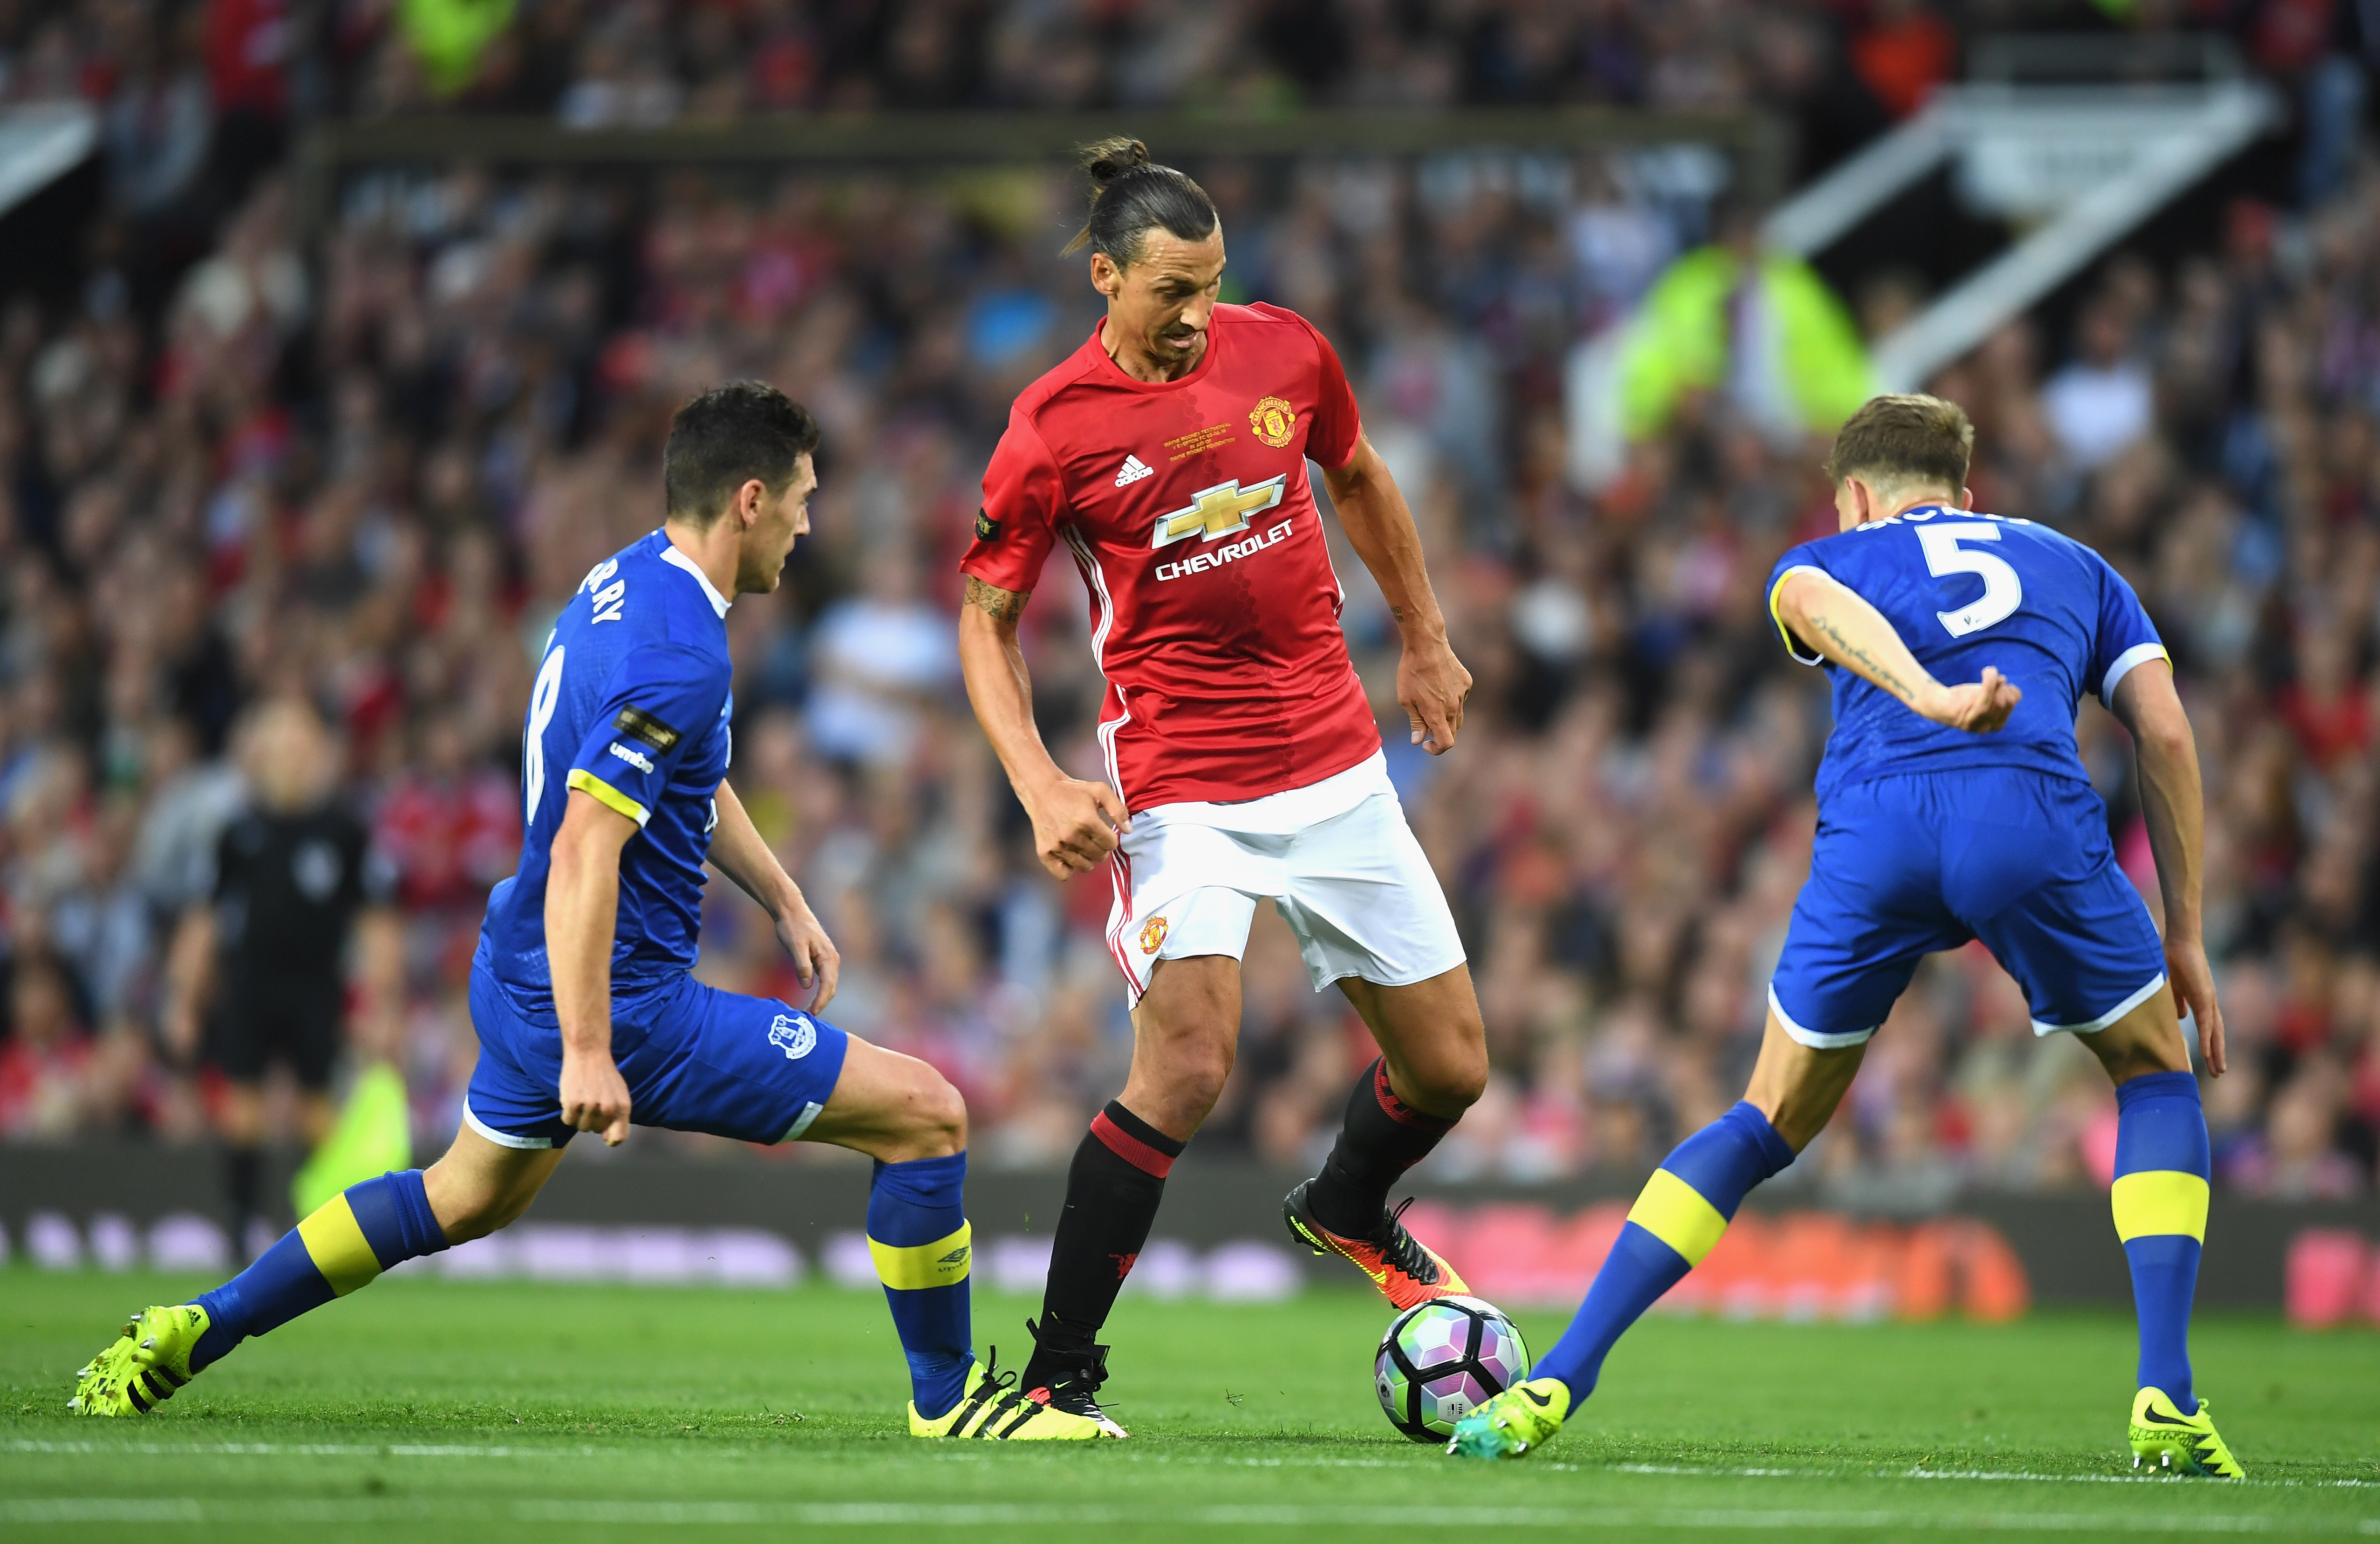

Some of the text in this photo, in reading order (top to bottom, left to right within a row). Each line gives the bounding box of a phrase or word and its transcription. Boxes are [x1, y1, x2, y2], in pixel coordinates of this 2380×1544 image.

[1254, 399, 1288, 421] MANCHESTER
[1164, 423, 1231, 447] WAYNE ROONEY TESTIMONIAL
[1177, 438, 1199, 448] EVERTON
[1268, 431, 1291, 444] UNITED
[1169, 437, 1235, 462] WAYNE ROONEY FOUNDATION
[1115, 466, 1154, 487] adidas
[1155, 519, 1293, 581] CHEVROLET
[1914, 521, 2022, 639] 5
[1142, 918, 1165, 939] MANCHESTER
